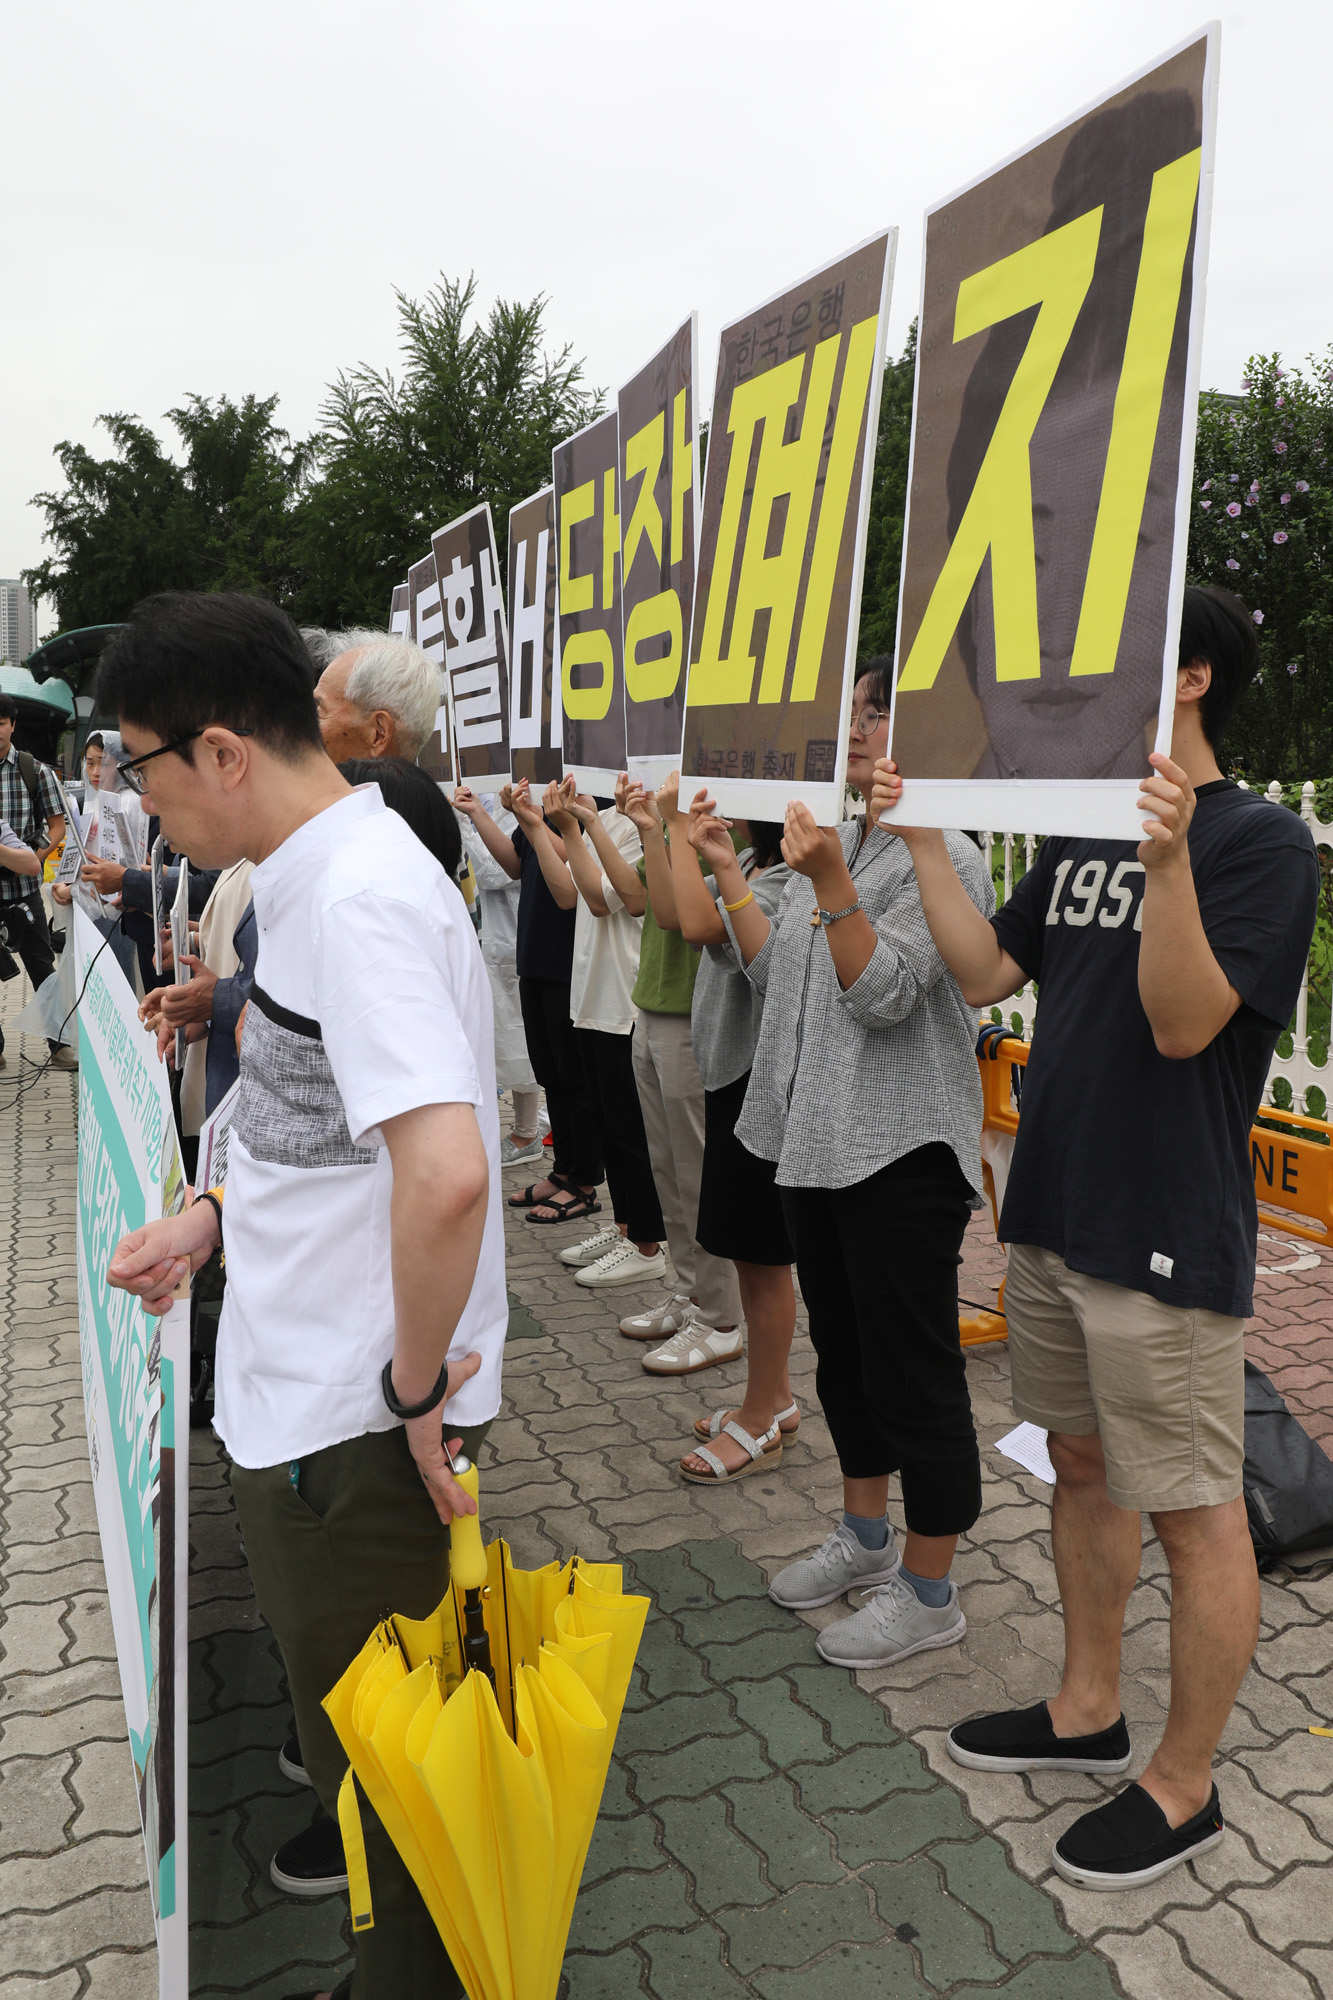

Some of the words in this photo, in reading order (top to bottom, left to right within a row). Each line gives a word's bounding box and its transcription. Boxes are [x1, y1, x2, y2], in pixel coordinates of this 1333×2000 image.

[736, 280, 846, 383] 한국은행
[897, 146, 1201, 692] 지
[560, 467, 621, 721] 당
[623, 387, 693, 703] 장
[687, 314, 878, 706] 폐
[442, 546, 503, 749] 활
[510, 528, 561, 749] 비
[696, 748, 756, 780] 한국은행
[761, 750, 796, 781] 총재
[1045, 859, 1146, 932] 195
[131, 1055, 148, 1121] 촉구
[92, 1141, 120, 1308] 당장
